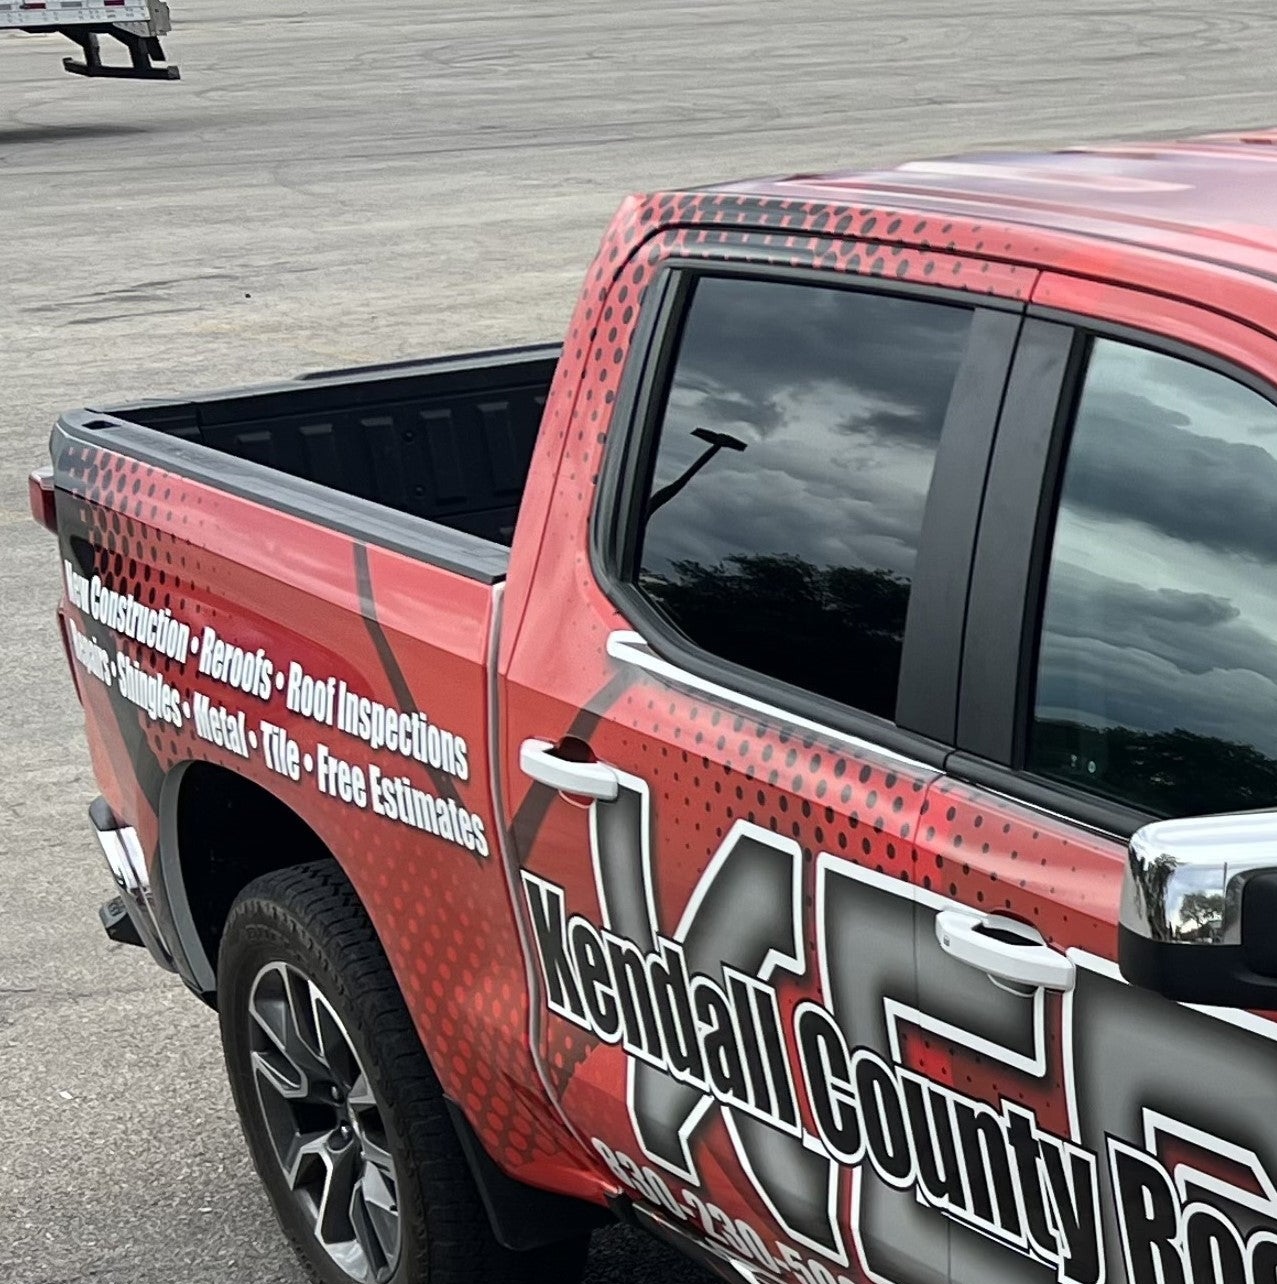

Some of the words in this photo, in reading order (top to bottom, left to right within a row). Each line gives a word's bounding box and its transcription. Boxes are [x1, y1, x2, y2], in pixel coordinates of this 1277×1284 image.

[90, 574, 190, 664] Construction
[198, 625, 274, 700] Reroofs
[286, 660, 337, 726] Roof
[337, 680, 469, 781] Inspections
[116, 650, 182, 728] Shingles
[192, 691, 249, 758] Metal
[259, 719, 301, 781] Tile
[316, 742, 367, 808] Free
[368, 763, 490, 857] Estimates
[519, 868, 806, 1139] Kendall
